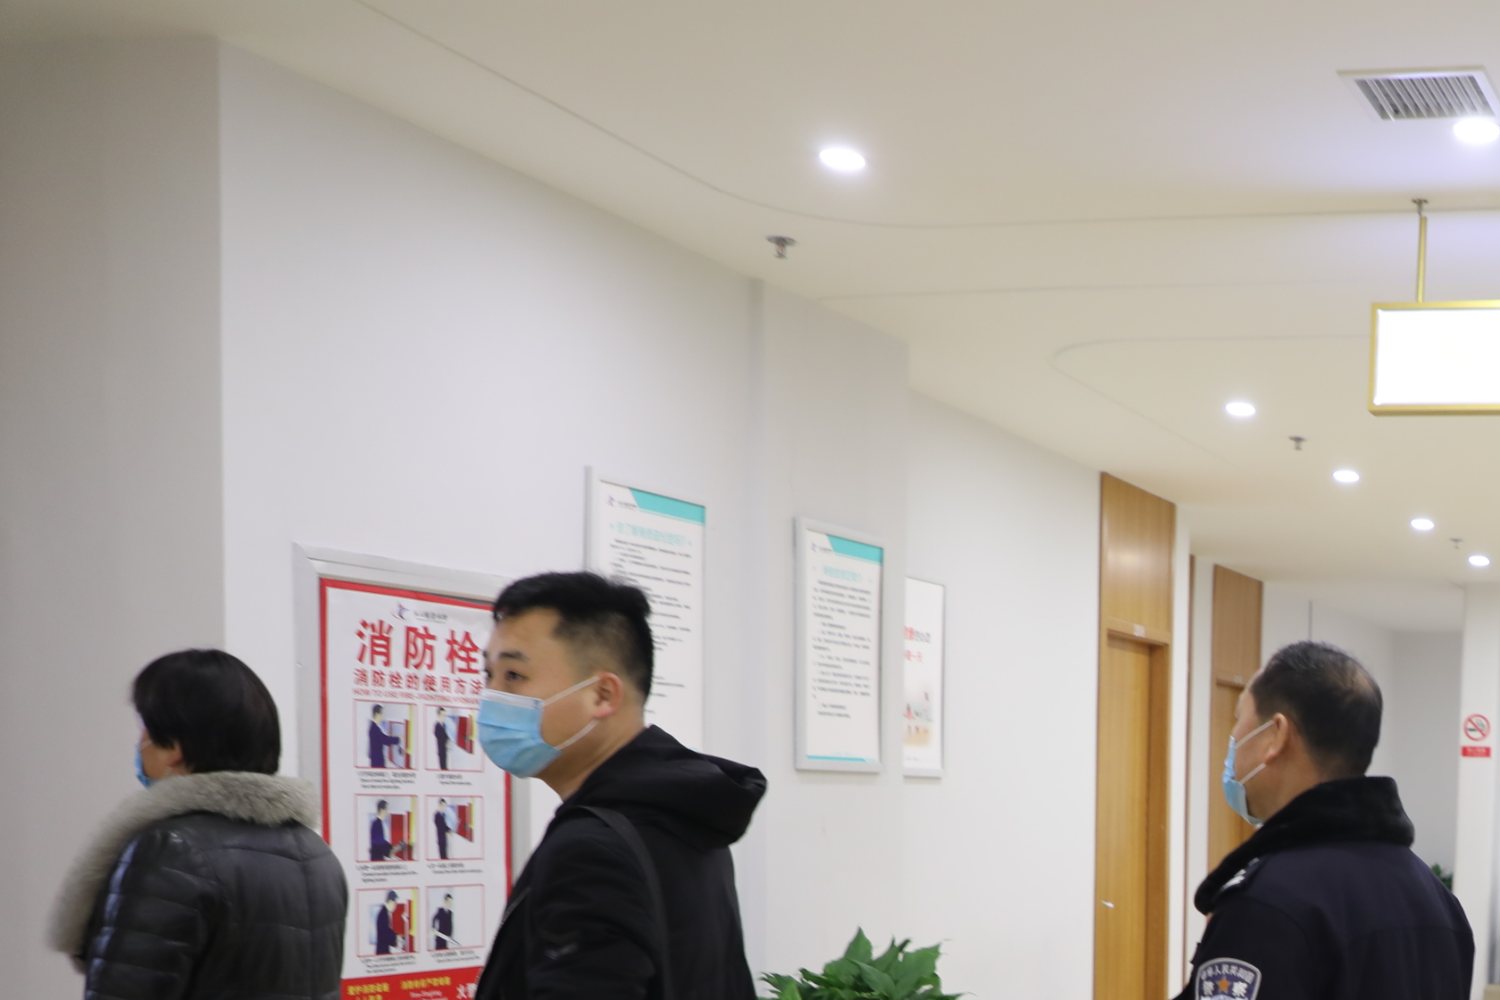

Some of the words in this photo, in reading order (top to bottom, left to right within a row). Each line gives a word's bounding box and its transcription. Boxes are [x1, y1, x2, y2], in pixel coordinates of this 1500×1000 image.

[354, 619, 481, 675] 消防栓
[354, 668, 484, 695] 消防栓的使用方法
